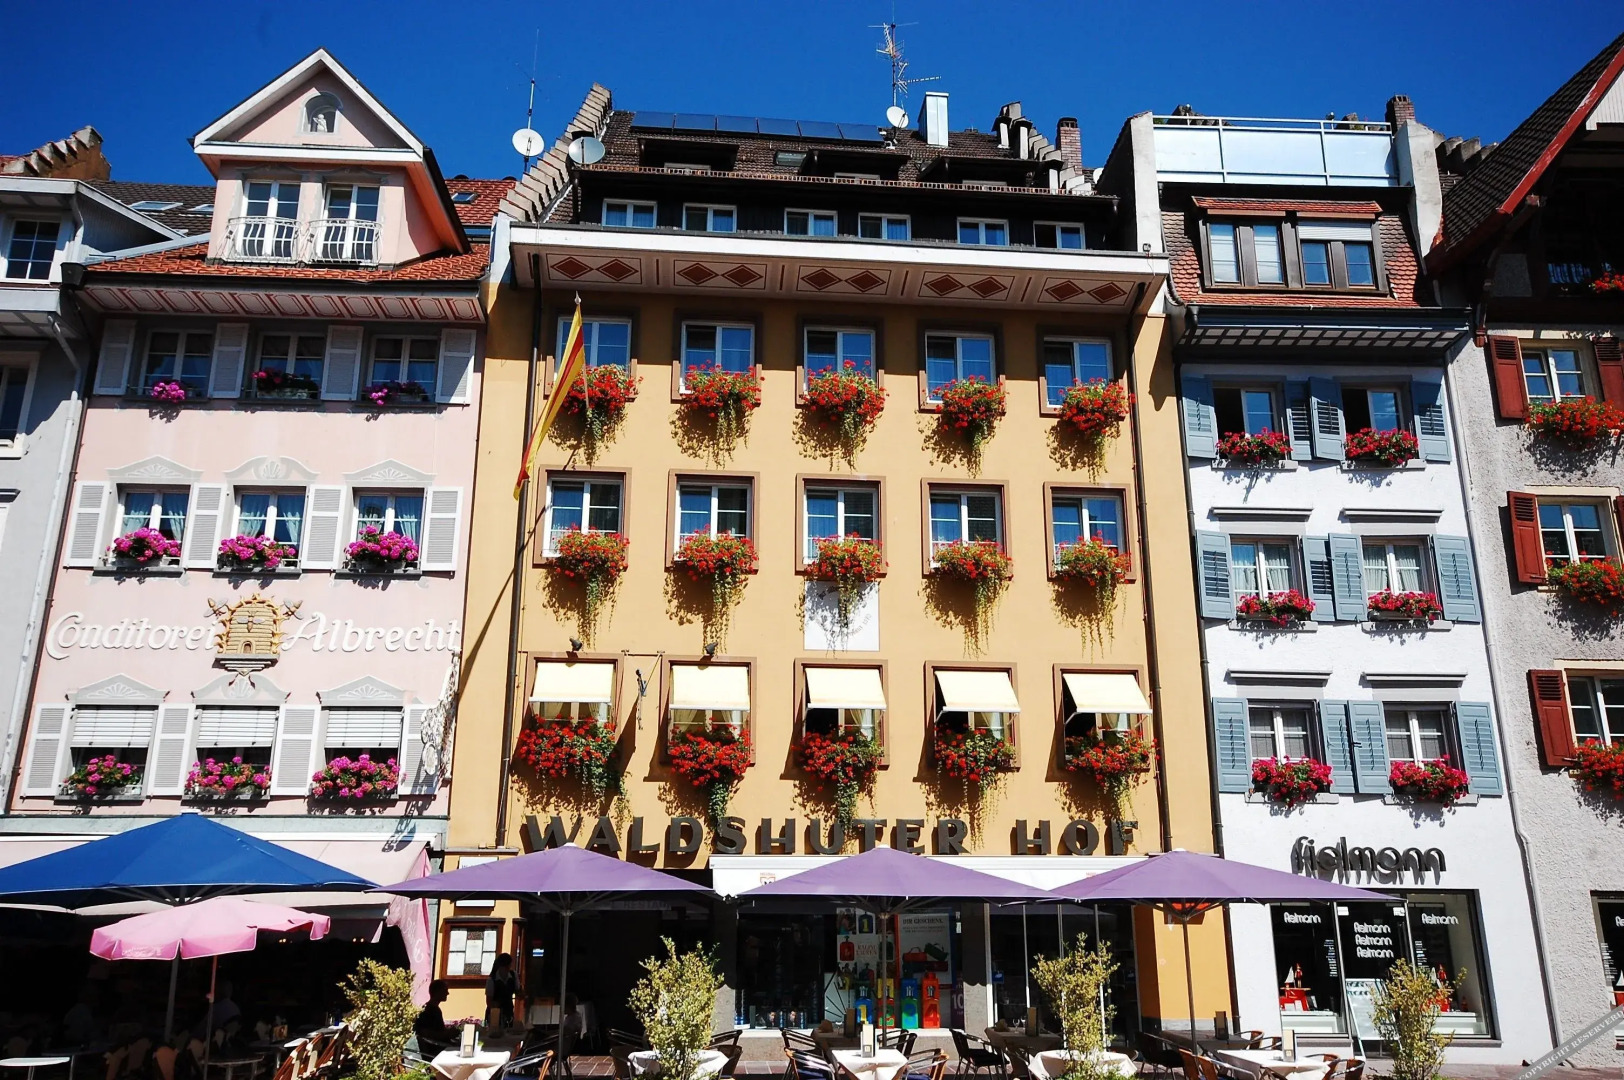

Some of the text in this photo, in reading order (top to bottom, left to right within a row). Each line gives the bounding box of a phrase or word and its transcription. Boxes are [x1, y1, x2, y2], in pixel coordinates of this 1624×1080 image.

[45, 611, 462, 660] Conditorei Albrecht
[526, 815, 1139, 856] WALDSHUTER HOF
[1297, 835, 1447, 872] fielmann
